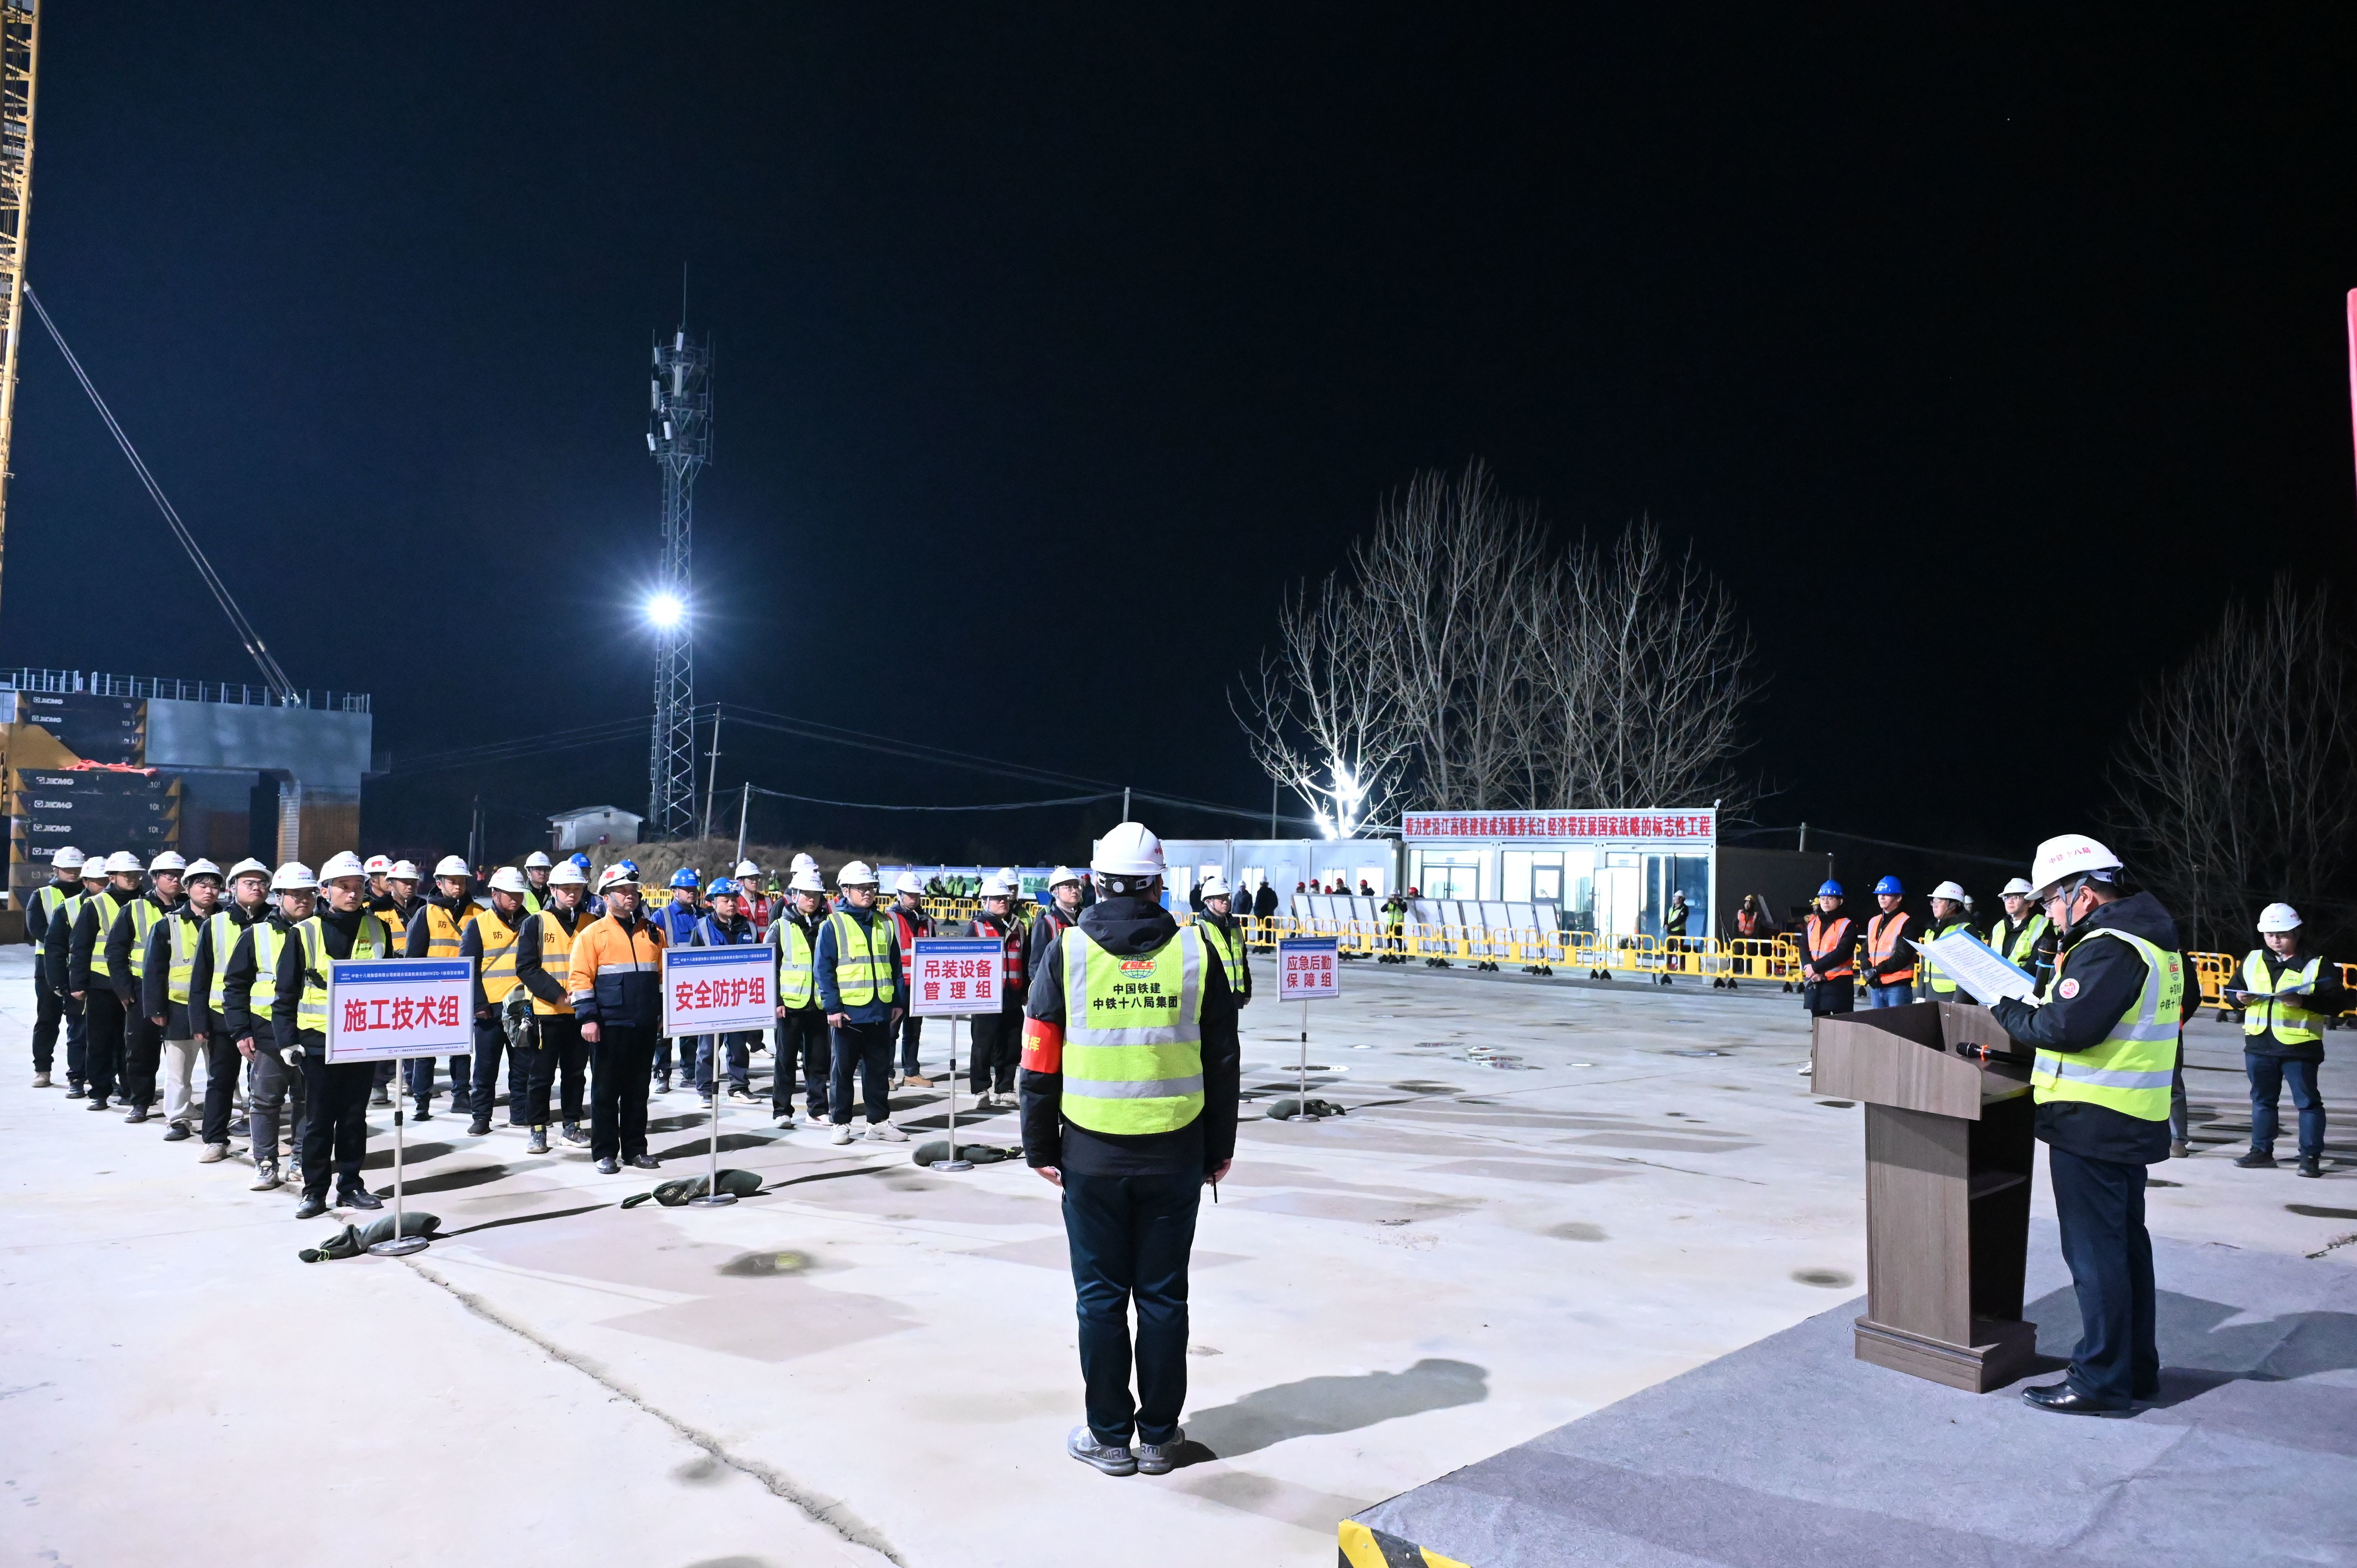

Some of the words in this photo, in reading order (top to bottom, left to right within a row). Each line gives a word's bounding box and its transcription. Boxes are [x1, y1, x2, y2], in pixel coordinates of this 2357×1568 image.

[1405, 816, 1711, 837] 着力把沿江高铁建设成为服务长江经济带发展国家战略的标志性工程
[2049, 847, 2091, 864] 中铁十八局
[438, 920, 447, 929] 防
[493, 931, 503, 940] 防
[544, 932, 555, 943] 防
[924, 959, 992, 979] 吊装设备
[1121, 961, 1155, 970] CRCC
[1287, 955, 1332, 971] 应急后勤
[1287, 972, 1332, 988] 保障组
[676, 977, 766, 1012] 安全防护组
[924, 980, 991, 1000] 管理组
[1113, 982, 1161, 995] 中国铁建
[1093, 996, 1178, 1010] 中铁十八局集团
[343, 995, 459, 1033] 施工技术组
